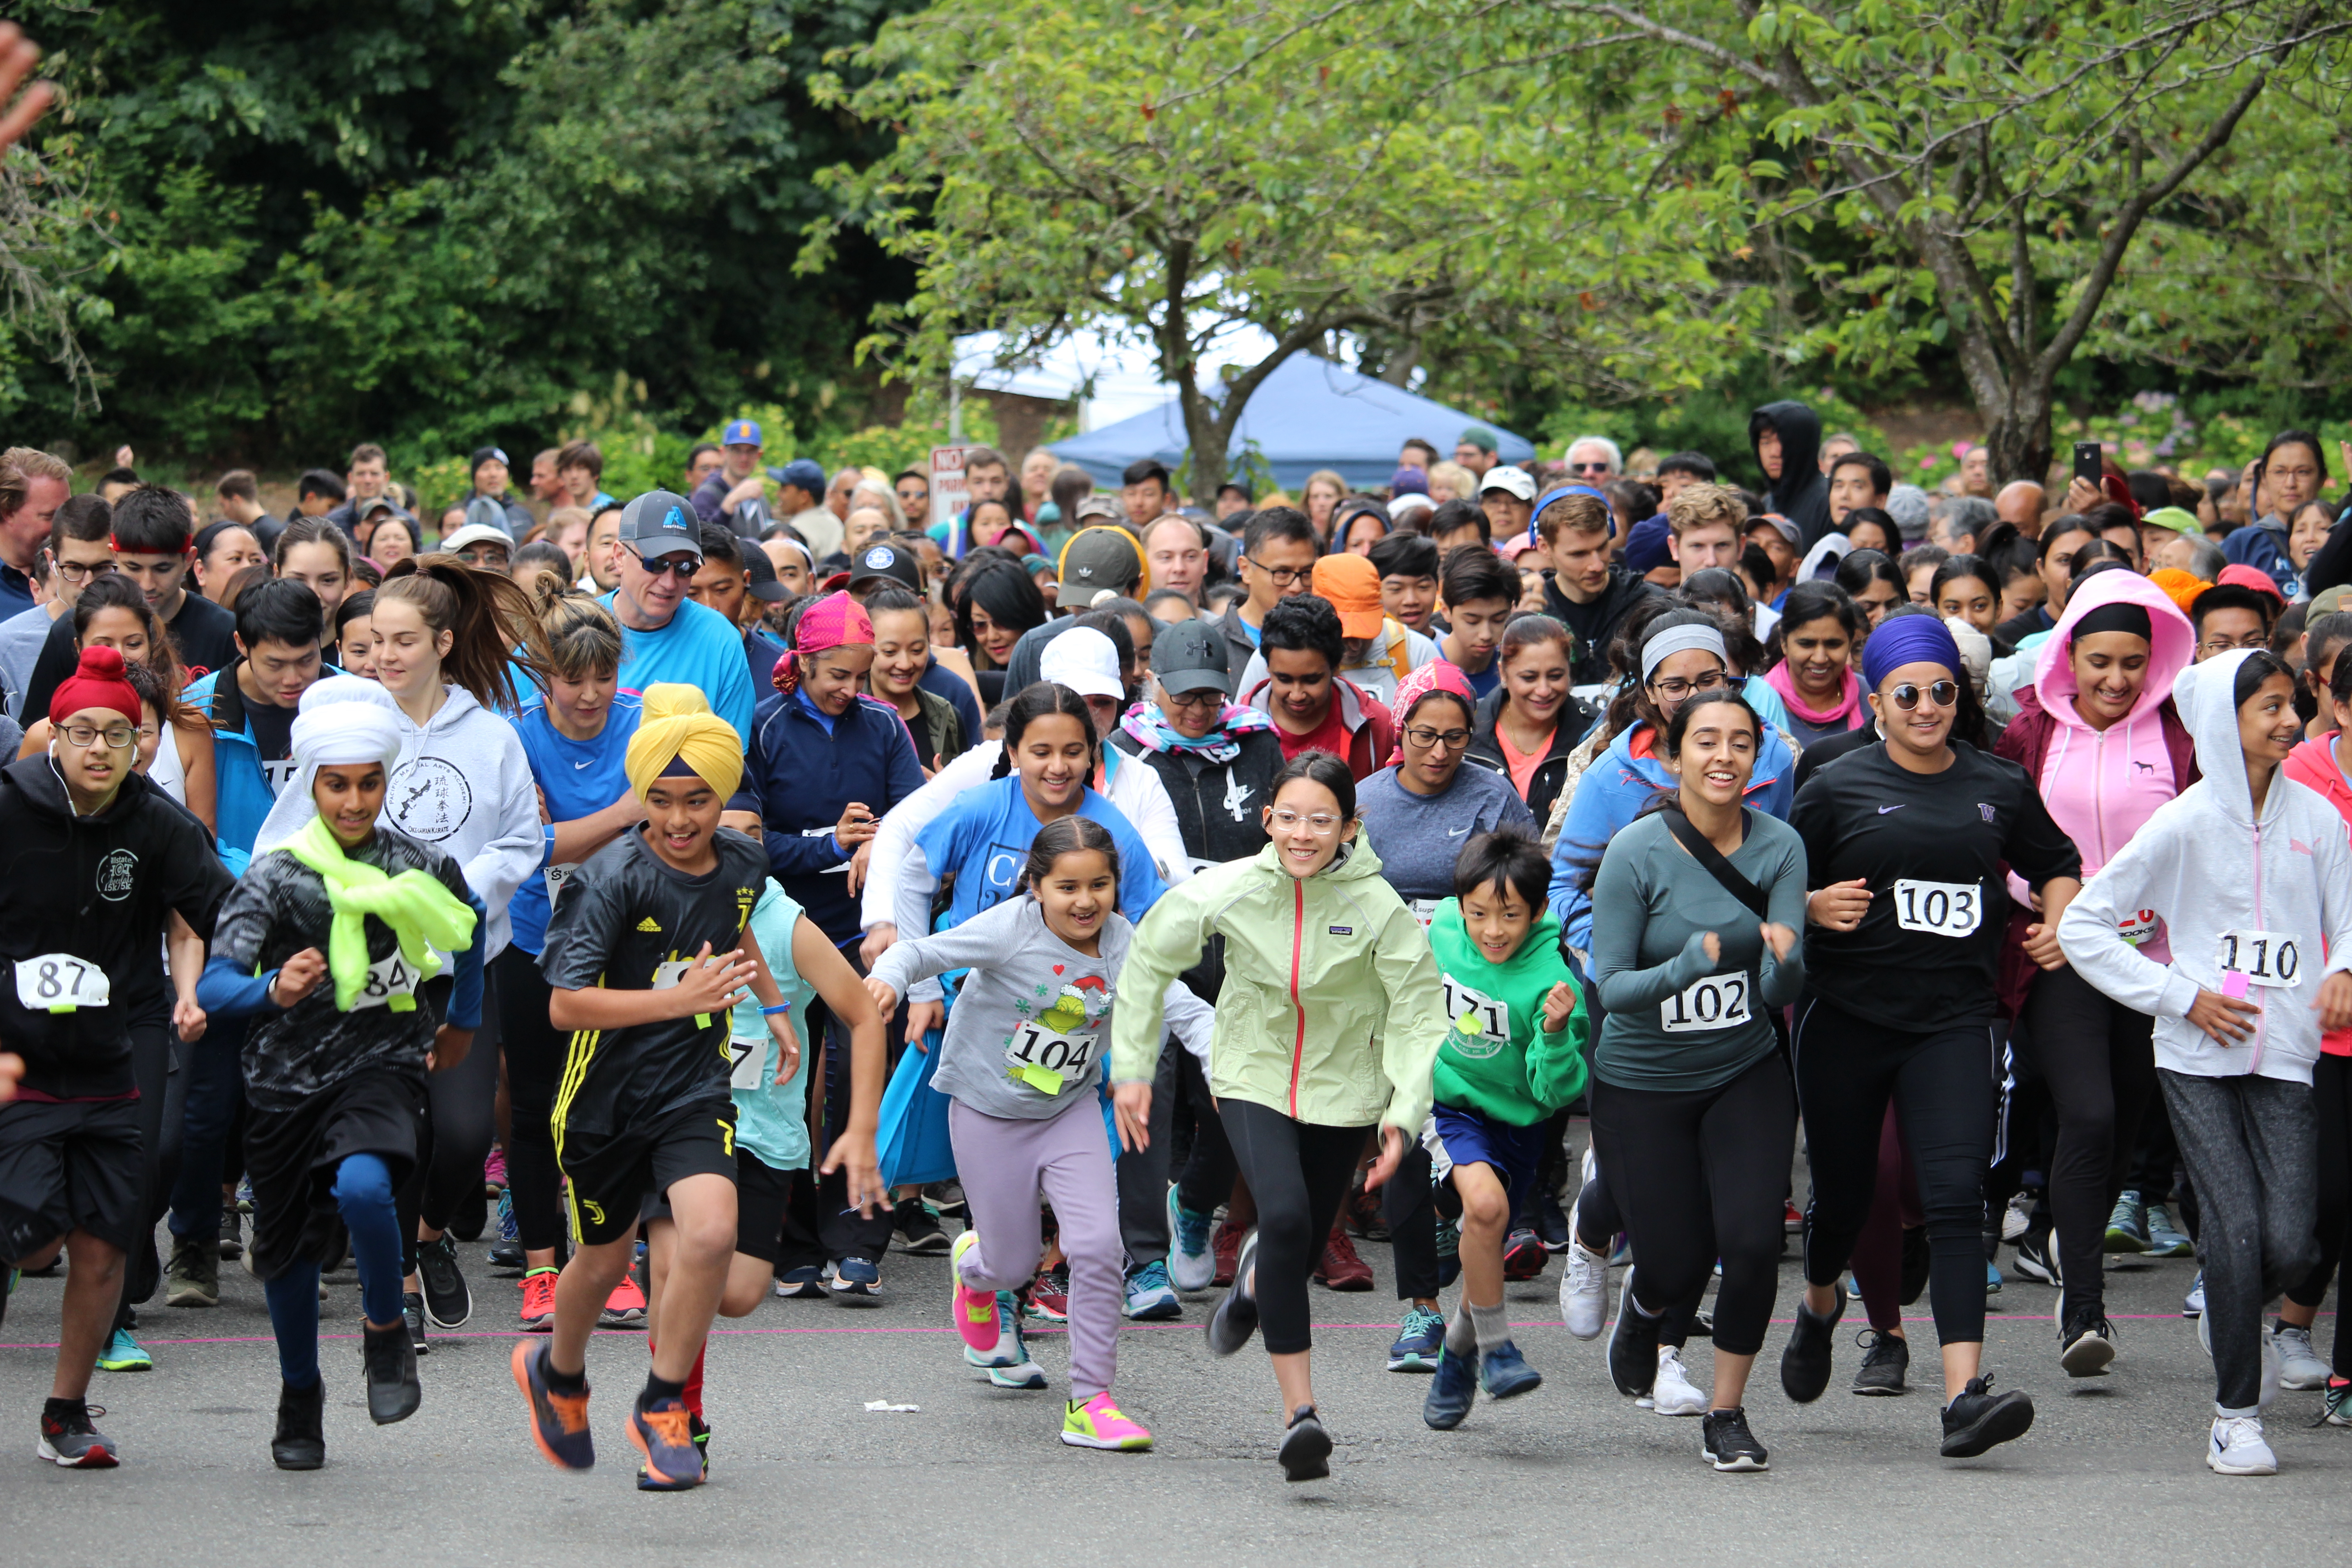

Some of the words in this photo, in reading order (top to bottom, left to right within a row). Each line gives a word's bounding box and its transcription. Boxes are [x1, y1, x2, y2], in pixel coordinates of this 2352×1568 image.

[936, 450, 962, 469] NO
[939, 479, 967, 493] PARK
[389, 778, 399, 805] PACIFIC
[399, 762, 429, 777] MAIAL
[432, 763, 451, 774] ARTS
[434, 775, 450, 823] 琉球拳法
[431, 825, 449, 834] KARATE
[1977, 803, 1995, 822] W
[1901, 887, 1975, 930] 103
[2118, 926, 2155, 937] ROOKS
[2221, 936, 2297, 980] 110
[38, 961, 86, 998] 87
[1444, 984, 1505, 1037] 171
[1670, 980, 1744, 1022] 102
[1014, 1029, 1090, 1073] 104
